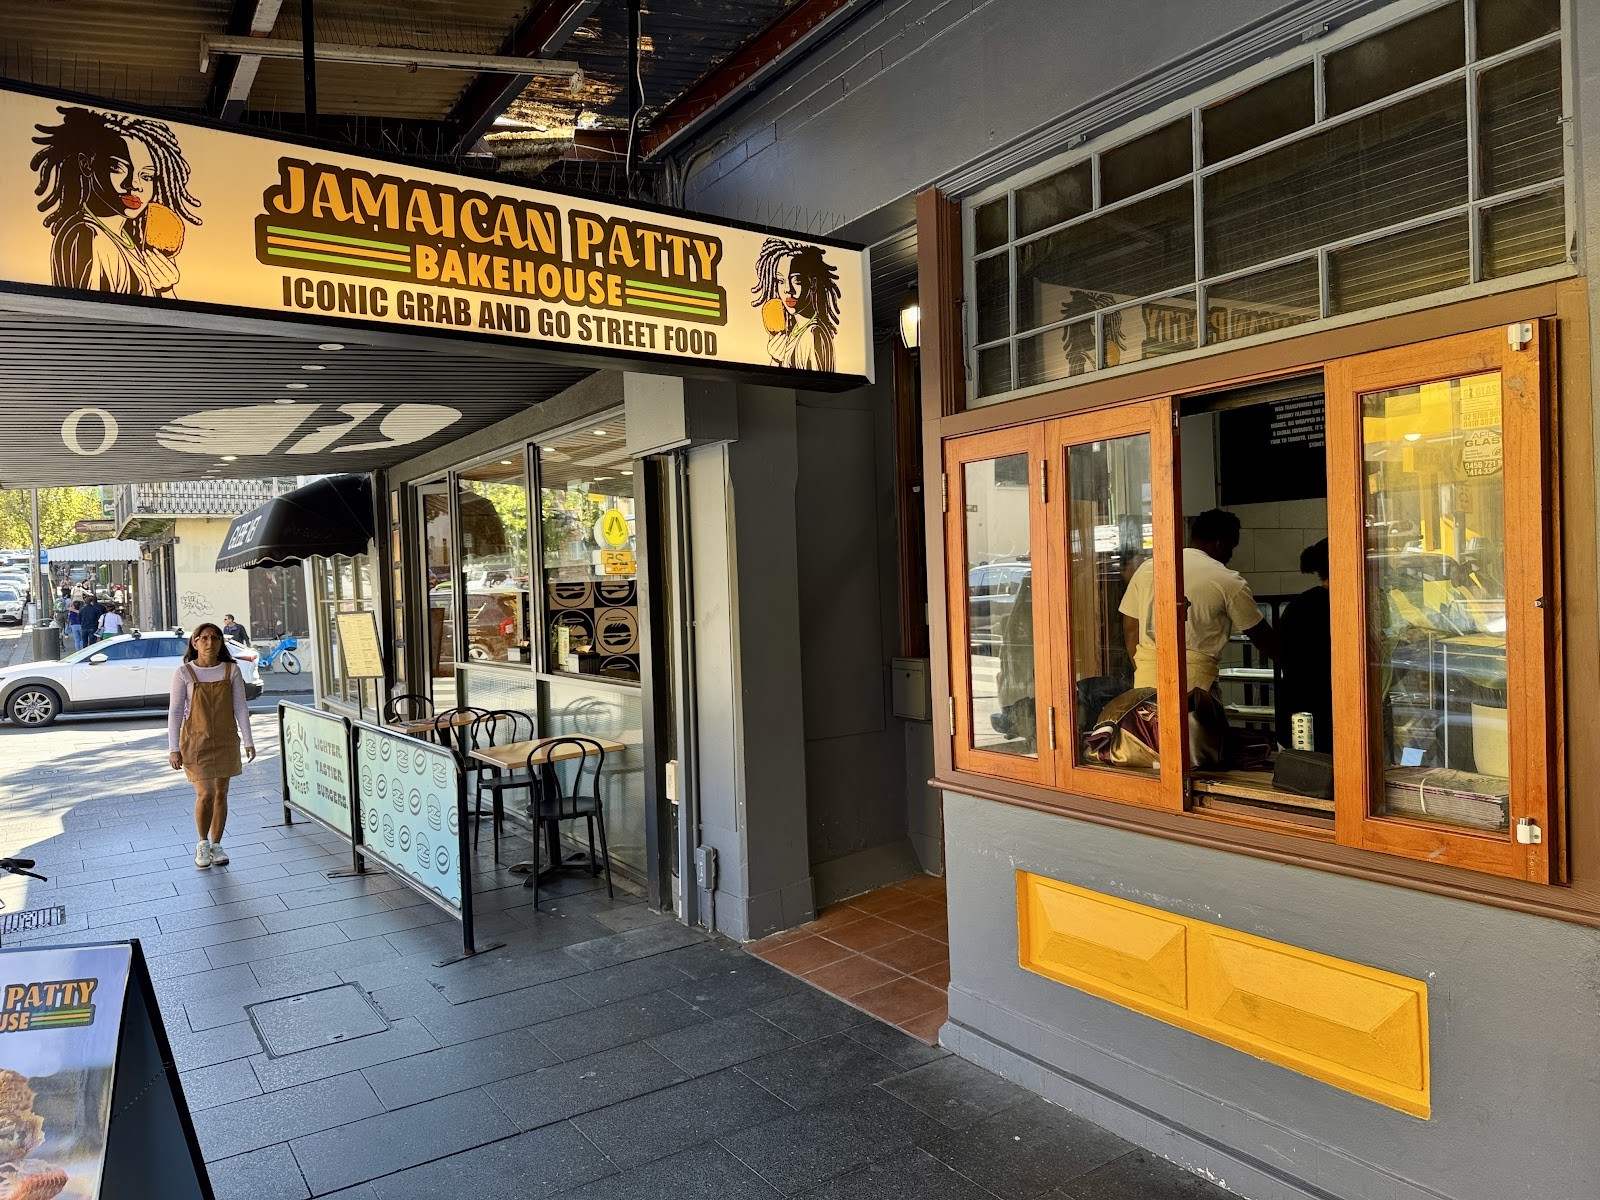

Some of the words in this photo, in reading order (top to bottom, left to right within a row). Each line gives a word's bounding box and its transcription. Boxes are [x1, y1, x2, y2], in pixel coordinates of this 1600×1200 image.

[272, 166, 556, 255] JAMAICAN
[574, 217, 717, 281] PATTY
[415, 244, 623, 307] BAKEHOUSE
[282, 275, 388, 317] ICONIC
[396, 289, 472, 326] GRAB
[478, 300, 531, 334] AND
[537, 308, 571, 339] GO
[577, 313, 658, 349] STREET
[663, 325, 718, 356] FOOD
[6, 981, 95, 1010] PATTY
